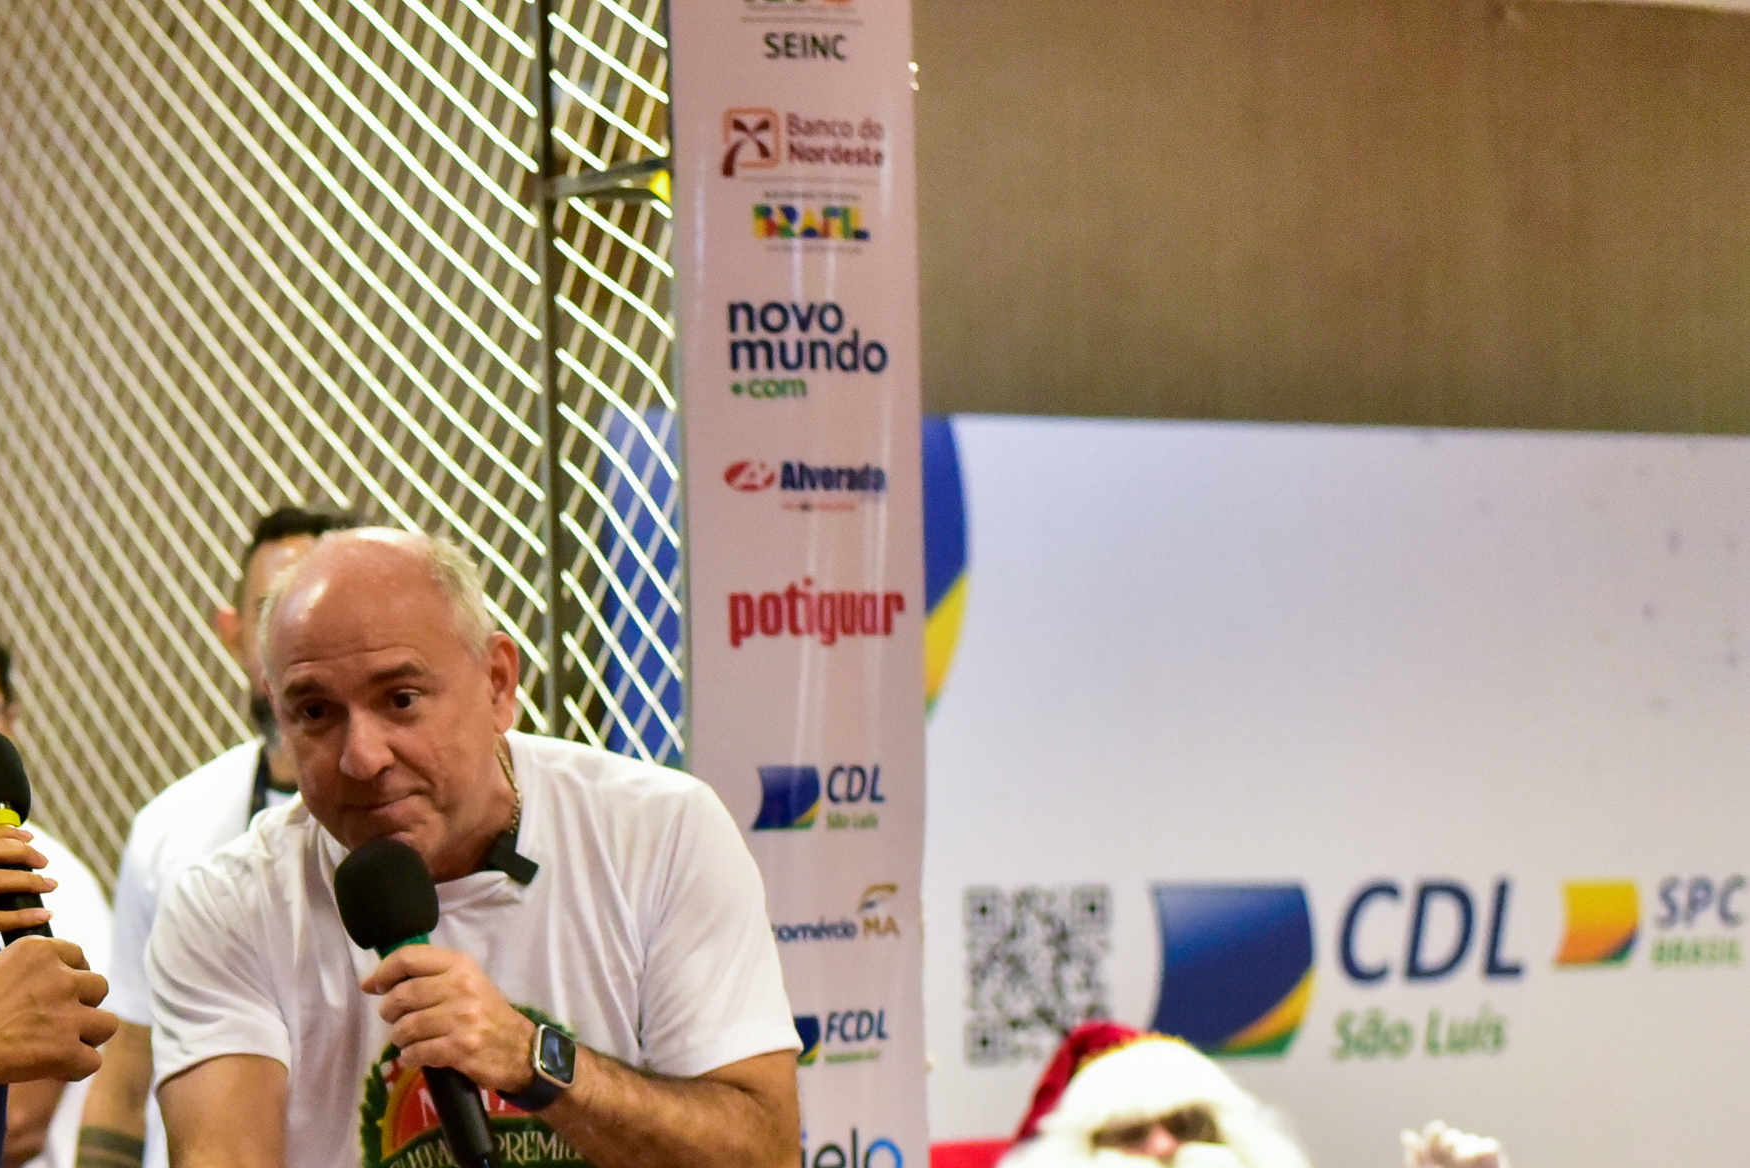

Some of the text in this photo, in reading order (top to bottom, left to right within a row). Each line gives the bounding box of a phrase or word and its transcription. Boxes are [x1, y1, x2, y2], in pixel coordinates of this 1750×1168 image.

[763, 31, 847, 61] SEINC
[786, 113, 884, 140] Banco do
[787, 143, 884, 167] Nordeste
[728, 301, 844, 334] novo
[730, 330, 889, 374] mundo
[728, 577, 907, 648] potiguar
[826, 764, 886, 804] CDL
[1653, 874, 1747, 930] SPC
[1337, 875, 1527, 987] CDL
[824, 1009, 890, 1043] FCDL
[1332, 1000, 1510, 1062] São Luís
